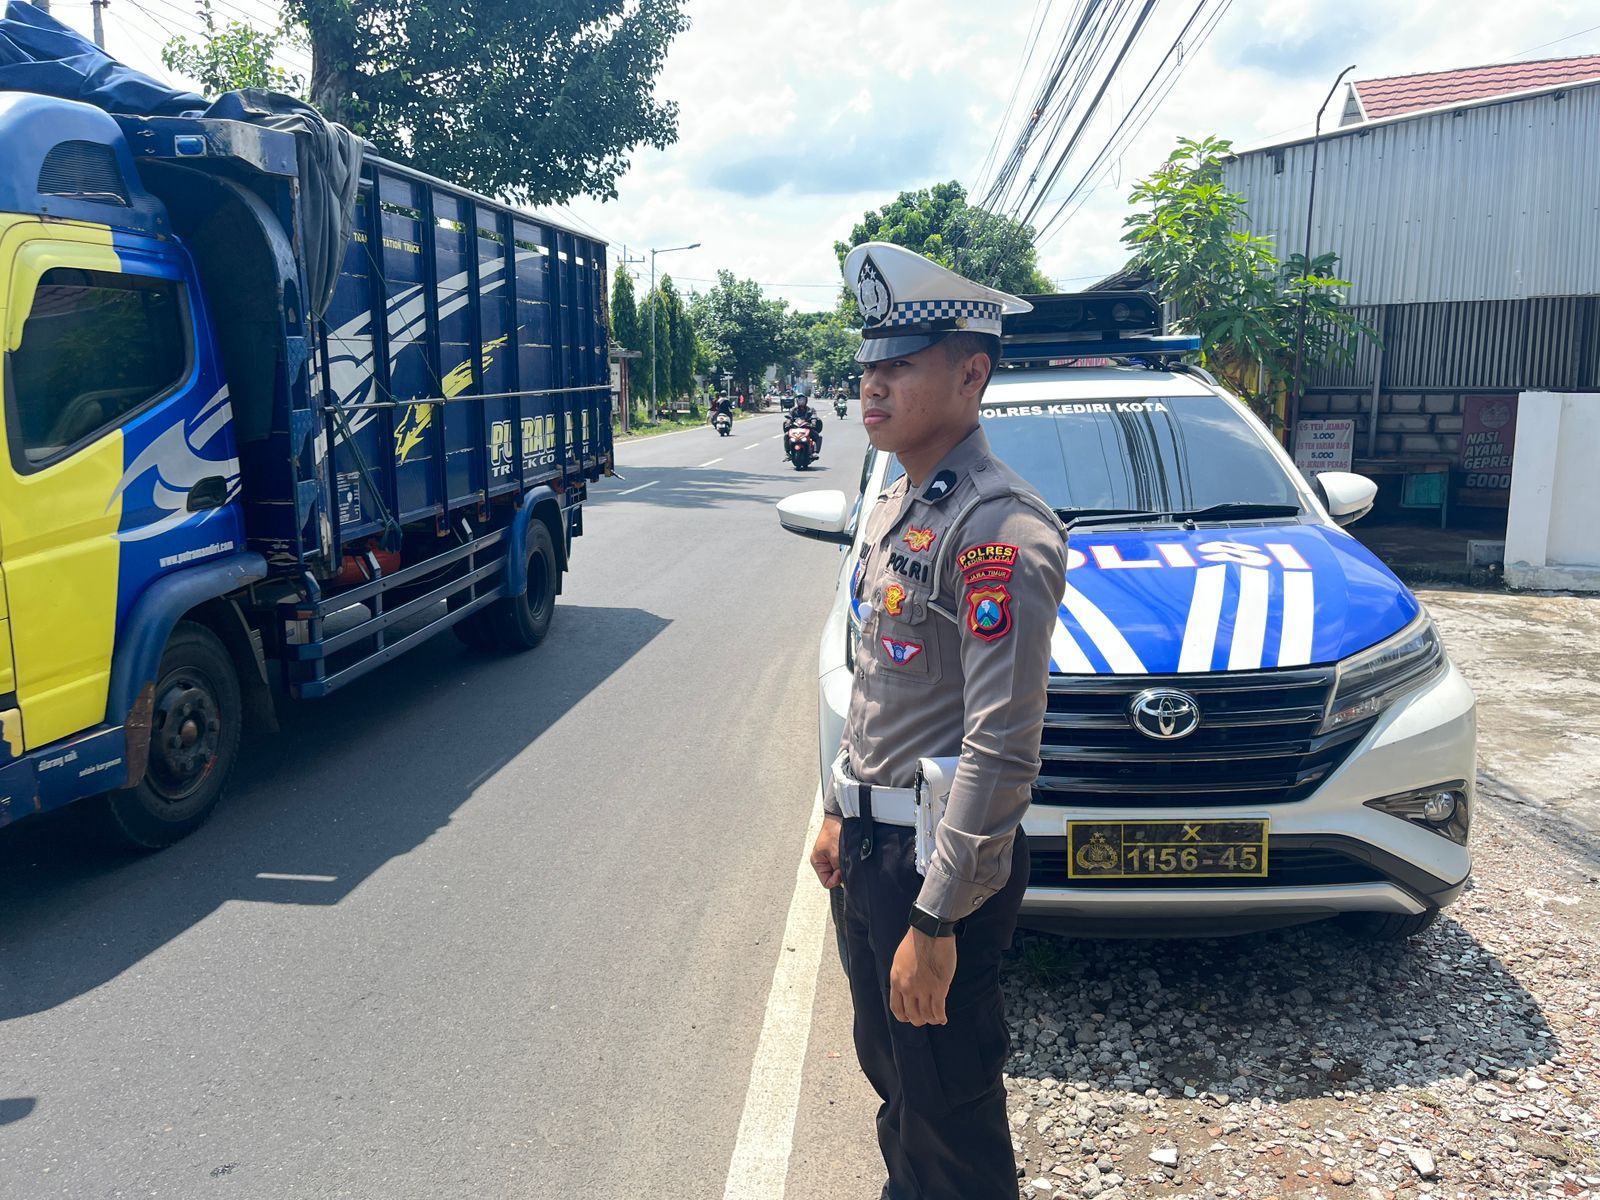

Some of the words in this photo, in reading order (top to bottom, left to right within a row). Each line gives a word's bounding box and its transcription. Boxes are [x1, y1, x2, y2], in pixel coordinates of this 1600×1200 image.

[404, 243, 421, 254] TRUCK
[1048, 403, 1112, 415] KEDIRI
[1117, 402, 1168, 413] KOTA
[491, 415, 545, 466] PURA
[1466, 431, 1499, 445] NASI
[1464, 444, 1503, 458] AYAM
[1465, 474, 1511, 489] 6000
[959, 545, 1013, 566] POLRES
[1066, 540, 1313, 570] LISI
[886, 551, 929, 584] POLRI
[969, 571, 986, 581] JAWA
[987, 569, 1007, 578] TIMUR
[1182, 825, 1202, 841] X
[1127, 847, 1258, 873] 1156-45
